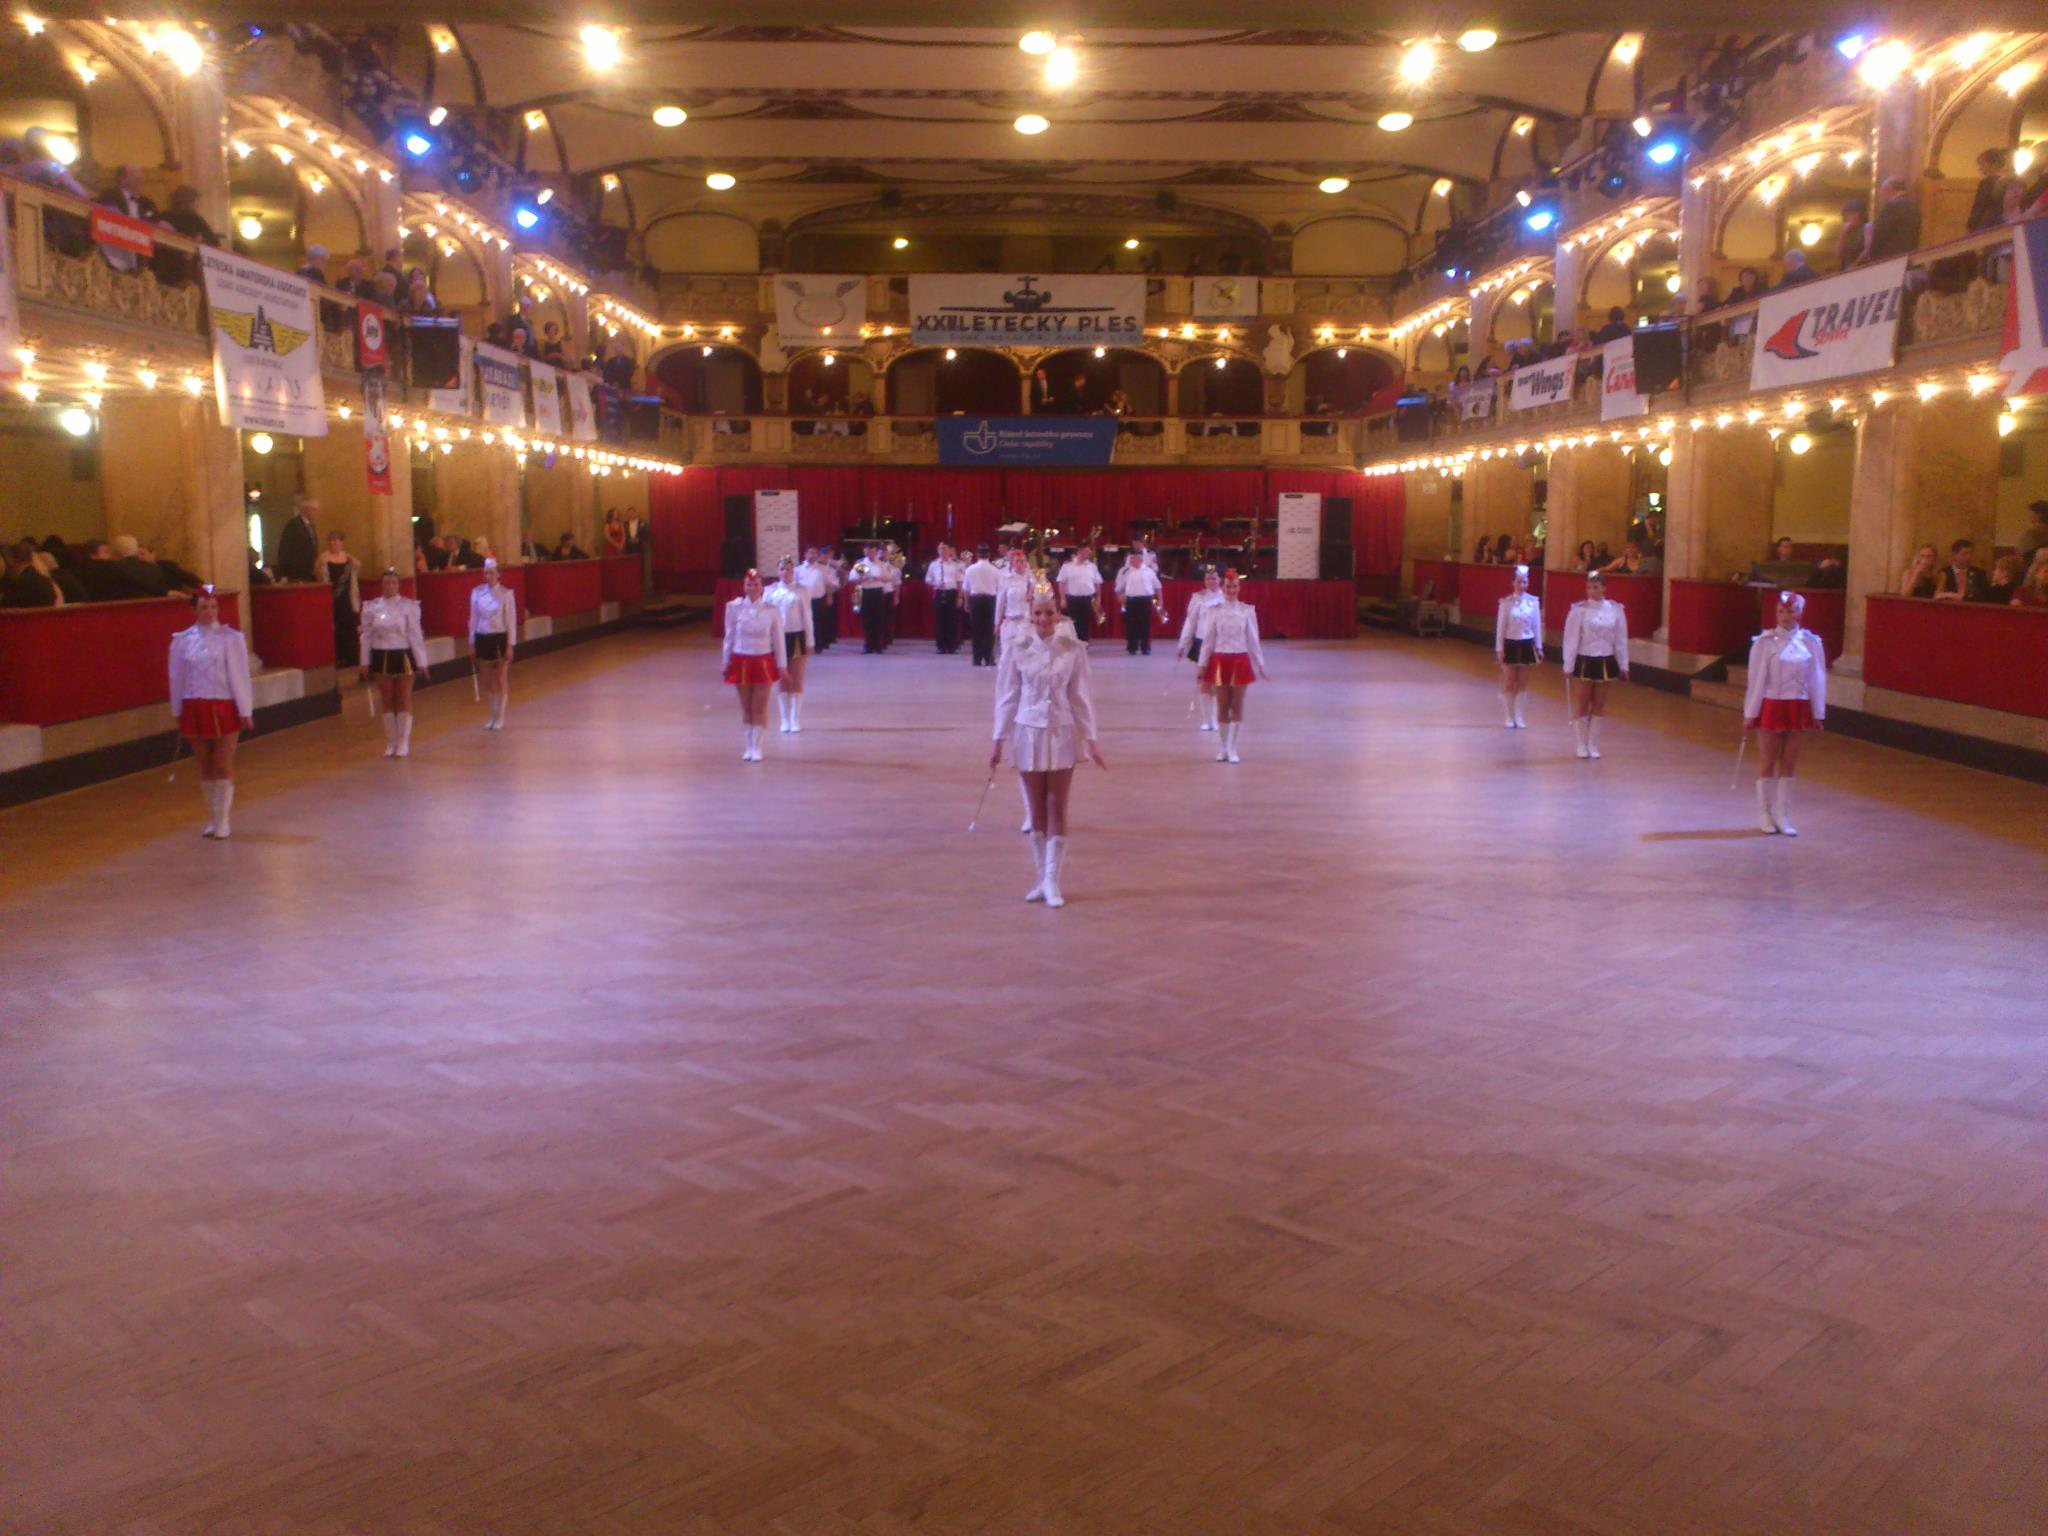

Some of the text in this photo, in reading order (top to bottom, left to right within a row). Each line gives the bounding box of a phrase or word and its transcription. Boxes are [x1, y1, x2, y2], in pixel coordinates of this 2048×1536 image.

[959, 312, 1068, 332] LETECKÝ
[1078, 316, 1137, 332] PLES
[1811, 286, 1901, 338] TRAVEL
